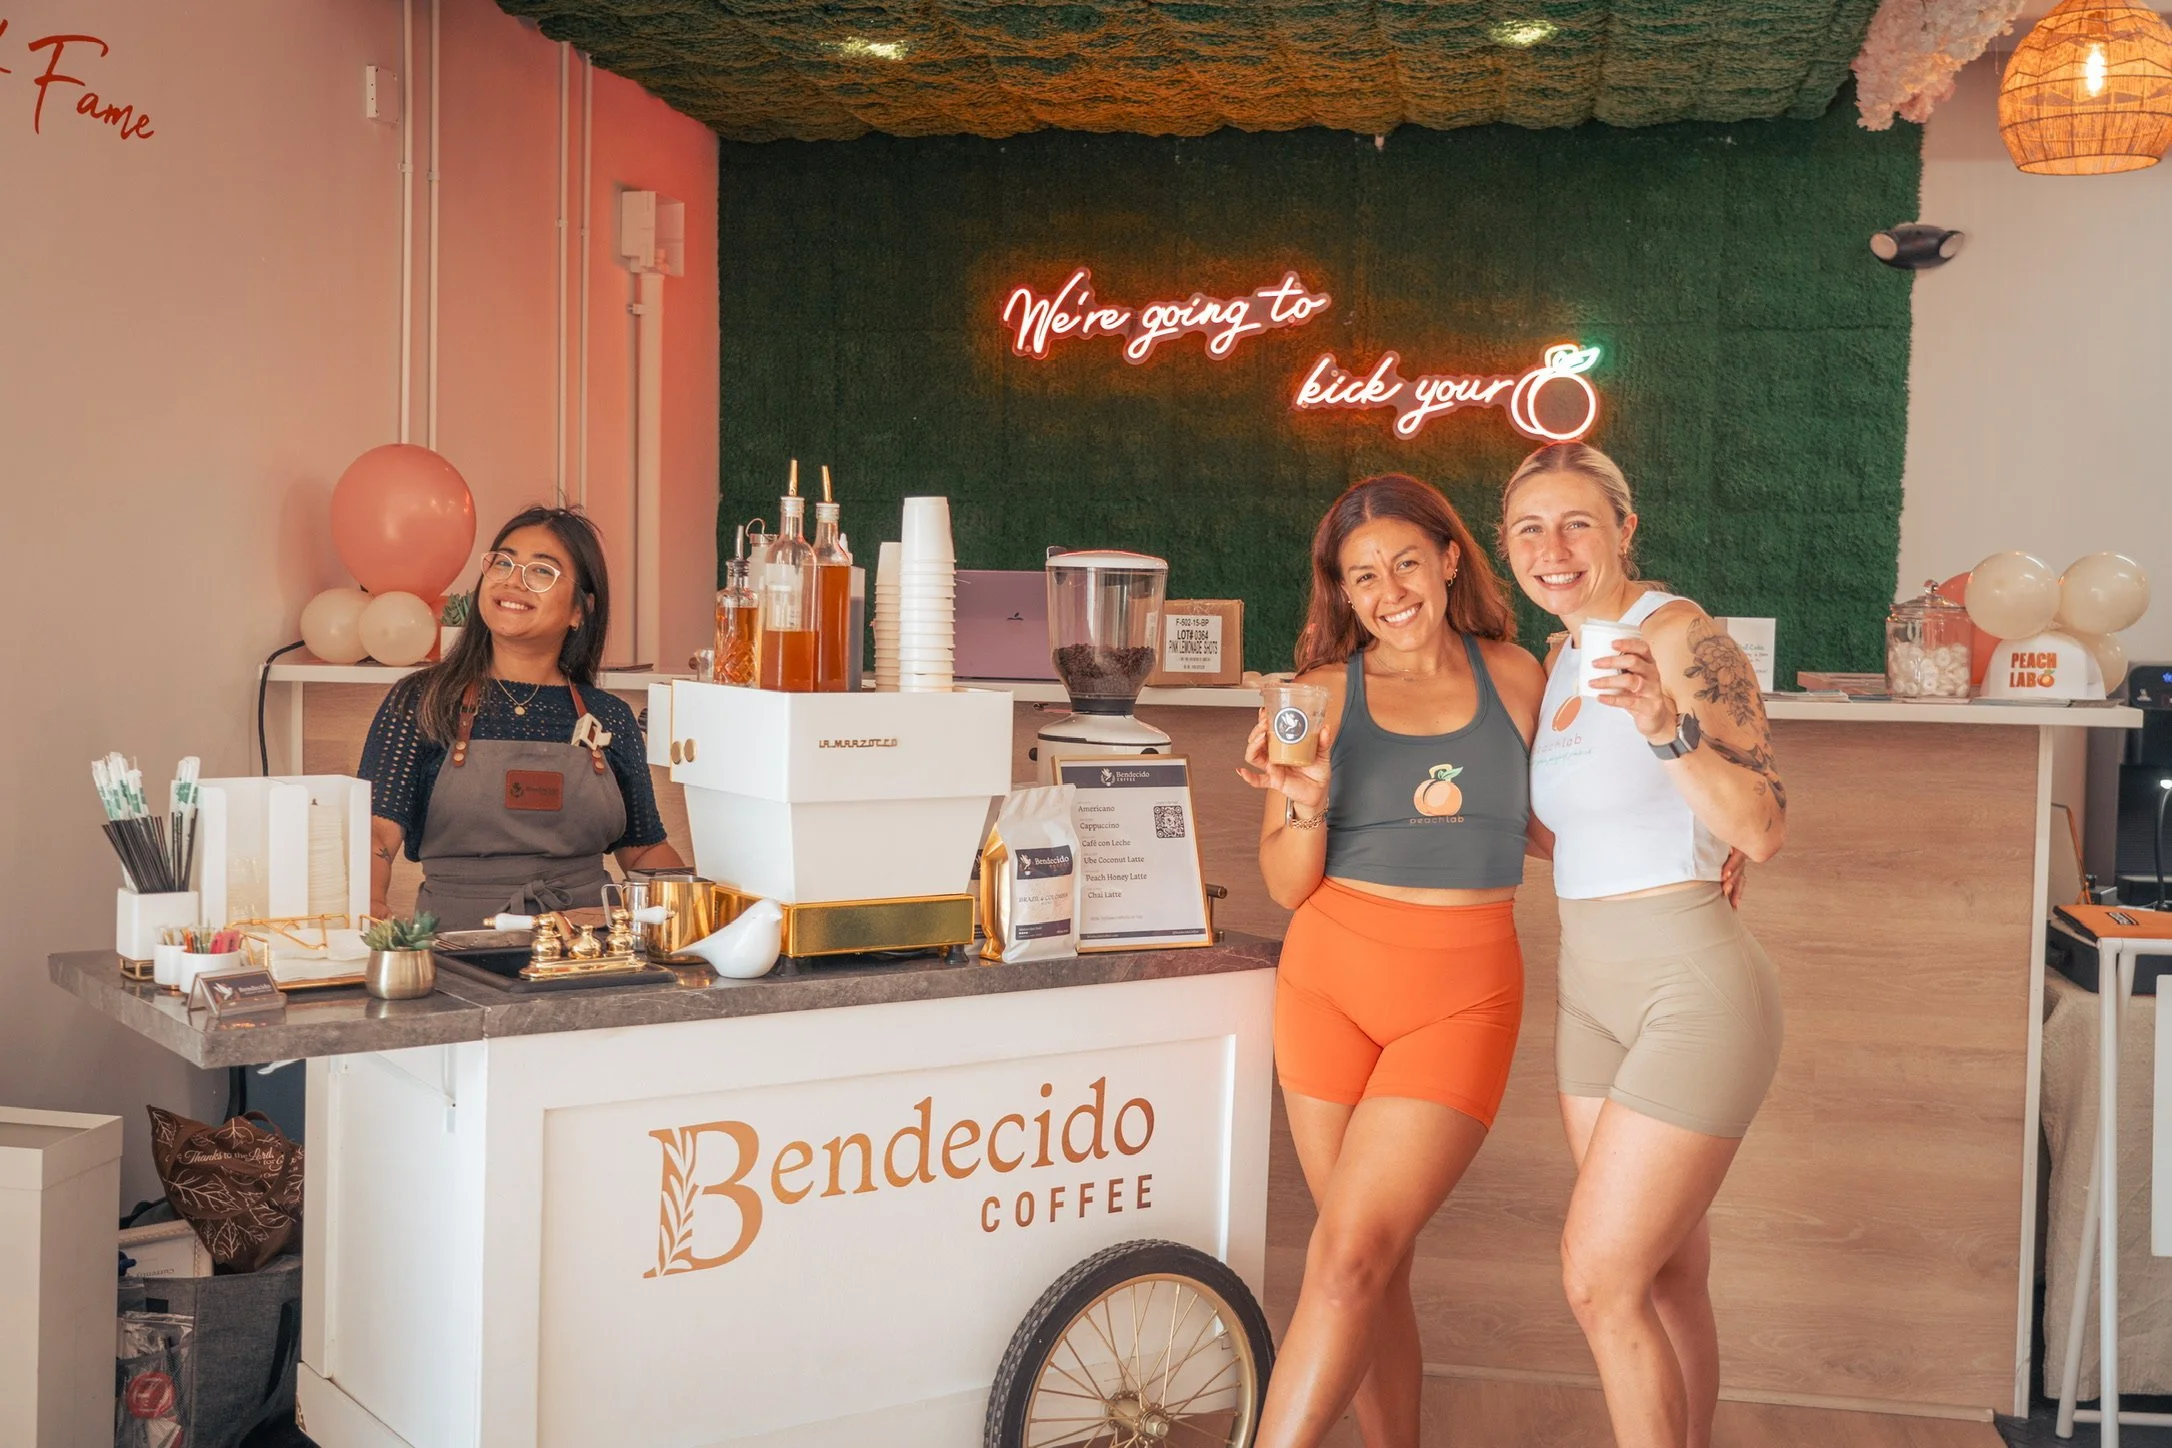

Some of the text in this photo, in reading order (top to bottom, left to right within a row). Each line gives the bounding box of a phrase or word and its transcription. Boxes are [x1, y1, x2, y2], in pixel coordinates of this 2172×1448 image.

[28, 34, 155, 140] Fame
[1004, 270, 1328, 360] We're going to
[1298, 356, 1514, 435] kick your
[1177, 629, 1193, 640] LOT#
[2010, 652, 2057, 669] PEACH
[2009, 671, 2037, 688] LAB
[834, 738, 898, 748] MARZOCCO
[1116, 770, 1150, 778] Bendecido
[1078, 805, 1115, 813] Americano
[1409, 814, 1465, 825] peachlab
[1079, 822, 1120, 832] Cappuccino
[1081, 839, 1097, 847] Café
[1111, 839, 1131, 847] Leche
[1034, 855, 1070, 866] Bendecido
[1083, 855, 1145, 864] Ube Coconut Latte
[1085, 872, 1147, 883] Peach Honey Latte
[1087, 891, 1122, 899] Chai Latte
[180, 1149, 222, 1165] Thanks
[642, 1076, 1155, 1279] Bendecido
[980, 1174, 1153, 1234] COFFEE
